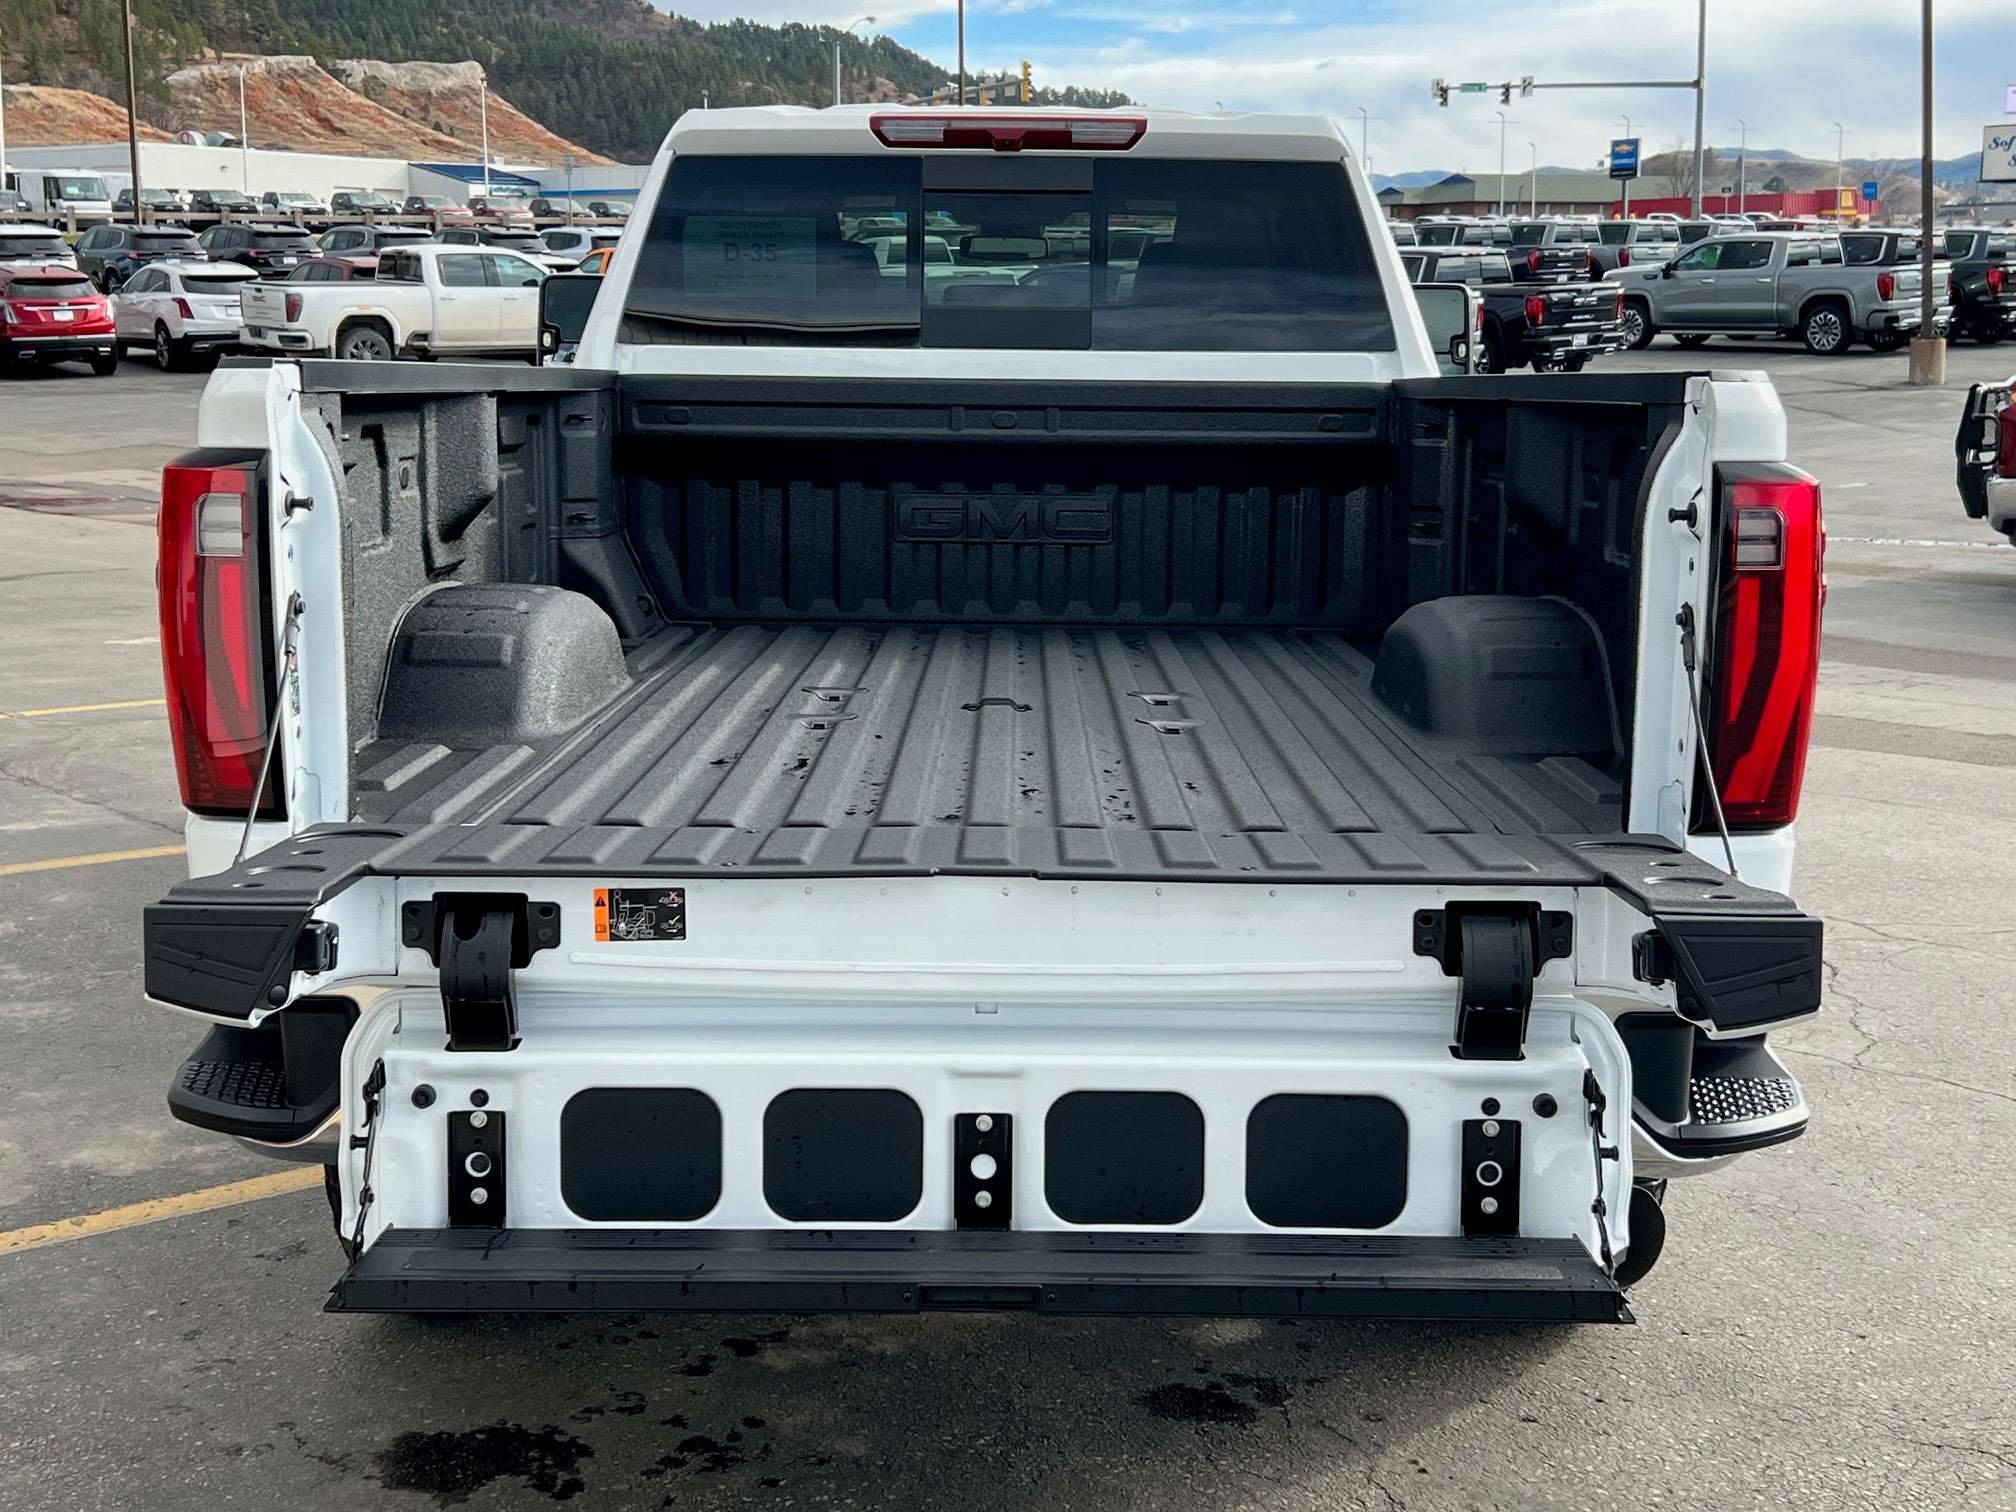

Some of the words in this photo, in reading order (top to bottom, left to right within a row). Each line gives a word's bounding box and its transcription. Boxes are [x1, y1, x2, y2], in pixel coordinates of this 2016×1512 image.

[717, 221, 746, 229] SOUTH
[748, 221, 783, 230] DAKOTA
[714, 231, 750, 239] VEHICLE
[751, 231, 785, 240] DEALER
[724, 242, 777, 262] D-35
[899, 498, 1110, 540] GMC
